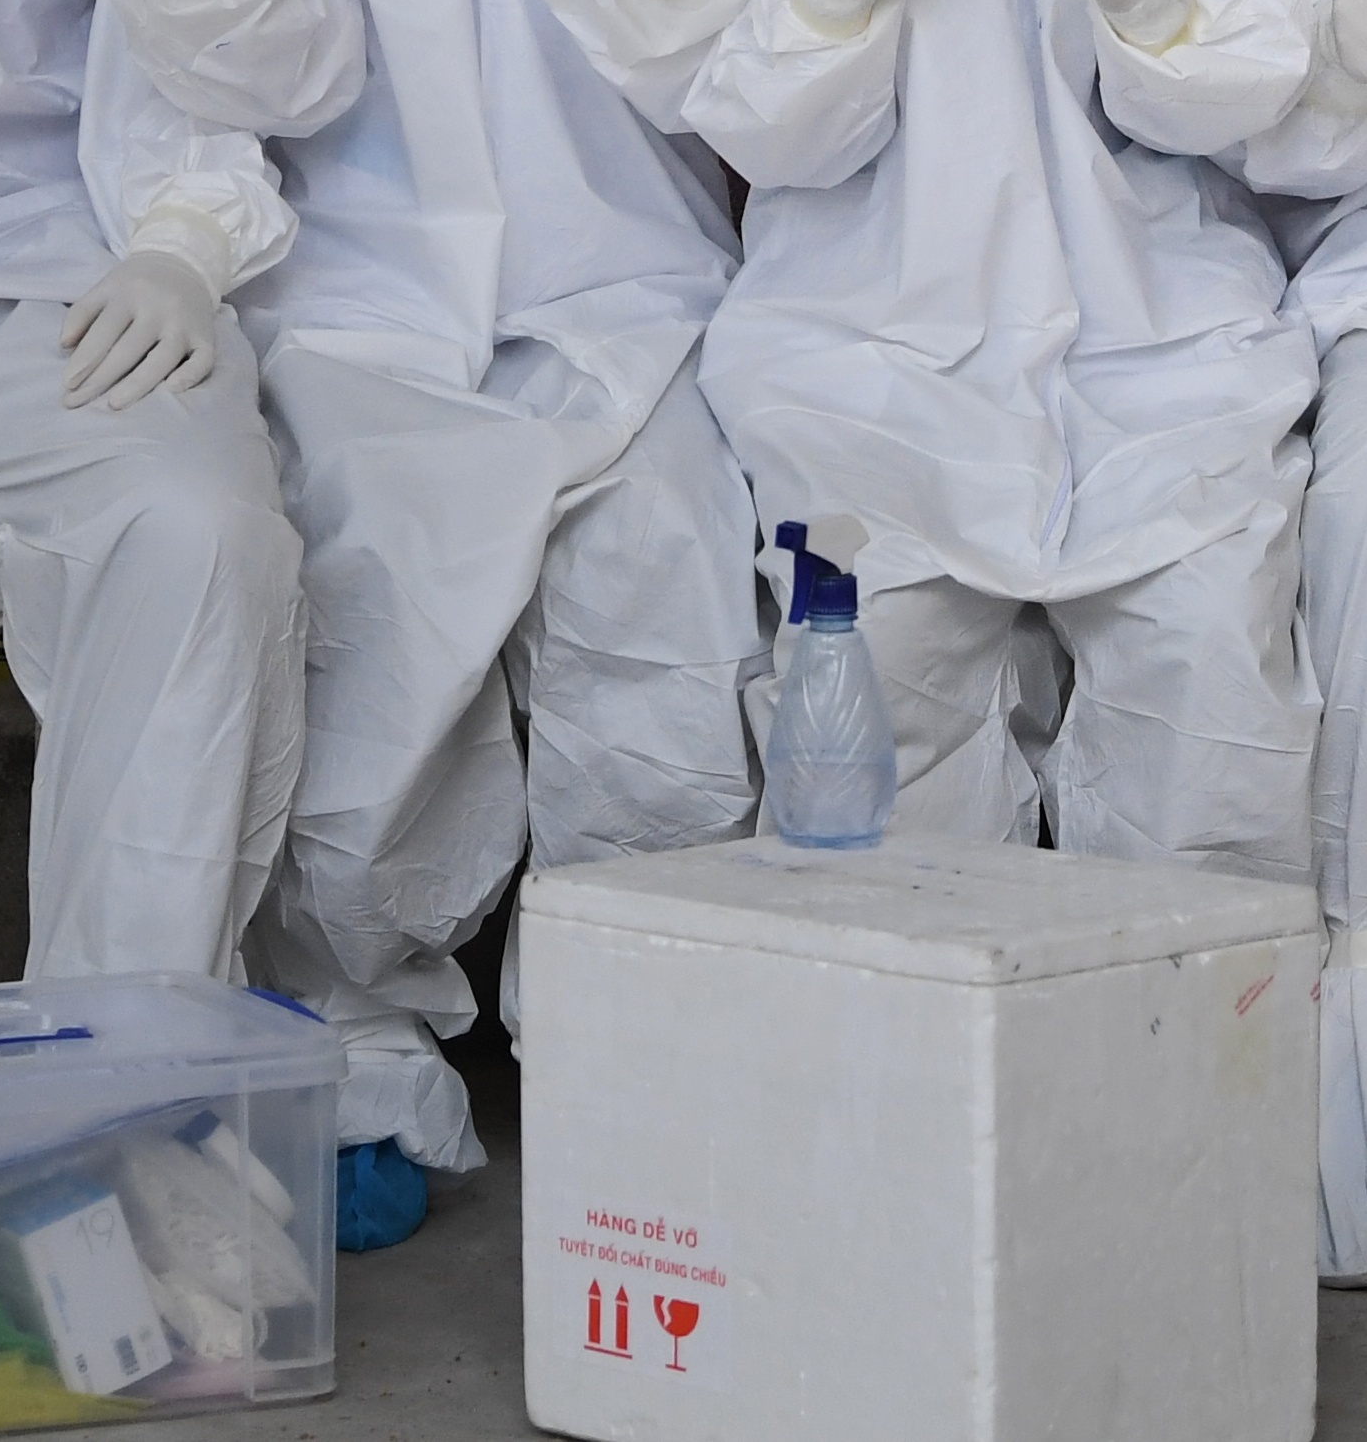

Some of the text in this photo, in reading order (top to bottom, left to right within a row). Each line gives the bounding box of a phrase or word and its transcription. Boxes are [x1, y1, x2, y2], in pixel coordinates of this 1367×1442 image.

[586, 1209, 698, 1249] HÀNG DỄ VỠ
